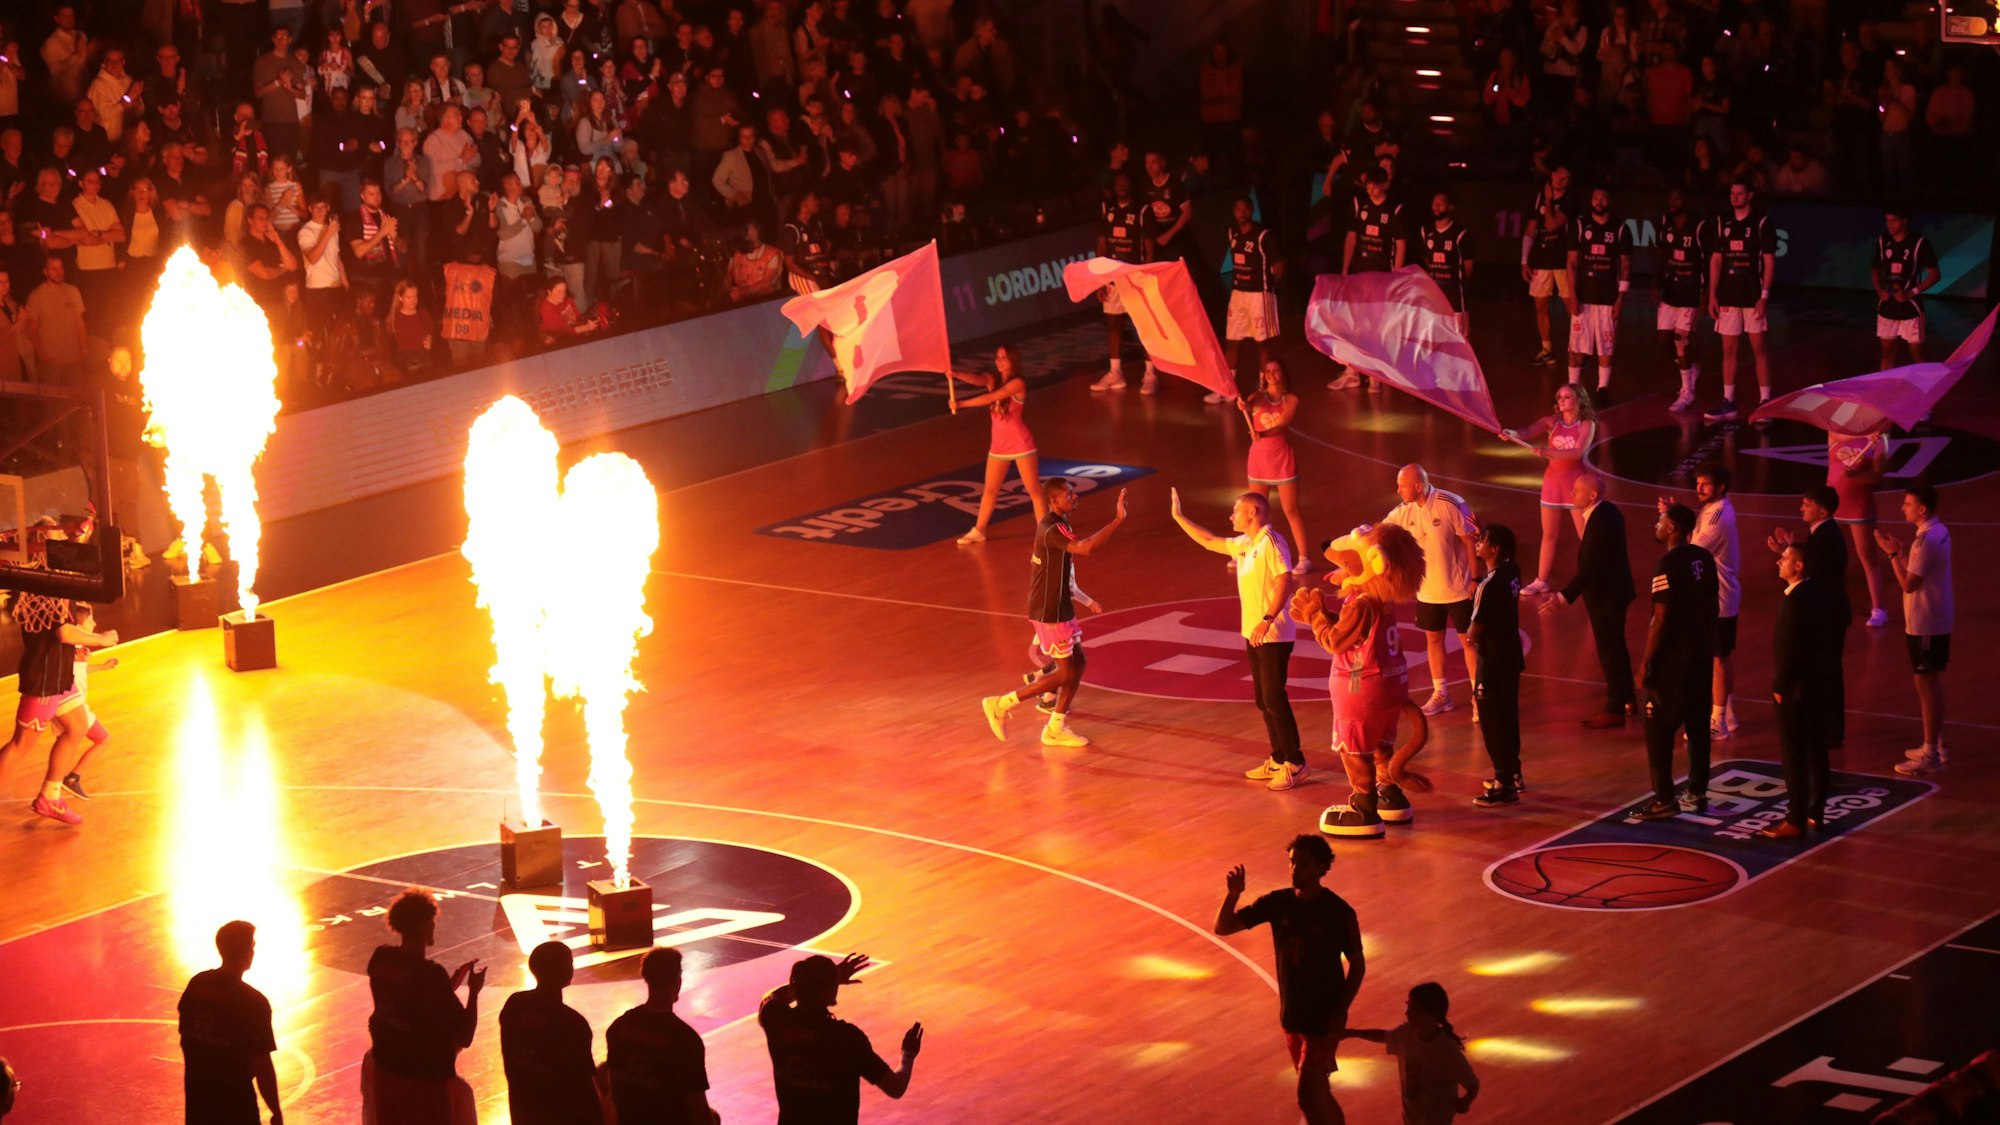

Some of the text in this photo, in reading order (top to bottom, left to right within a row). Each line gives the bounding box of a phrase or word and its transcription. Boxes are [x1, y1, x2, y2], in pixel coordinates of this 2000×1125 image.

[1125, 213, 1136, 225] 32
[1496, 211, 1522, 239] 11
[1604, 231, 1615, 244] 55
[1744, 226, 1751, 239] 3
[1682, 235, 1693, 248] 27
[1903, 249, 1910, 260] 2
[952, 258, 1067, 314] 11 JORDAN
[443, 307, 482, 321] MEDIA
[772, 479, 986, 540] Credit
